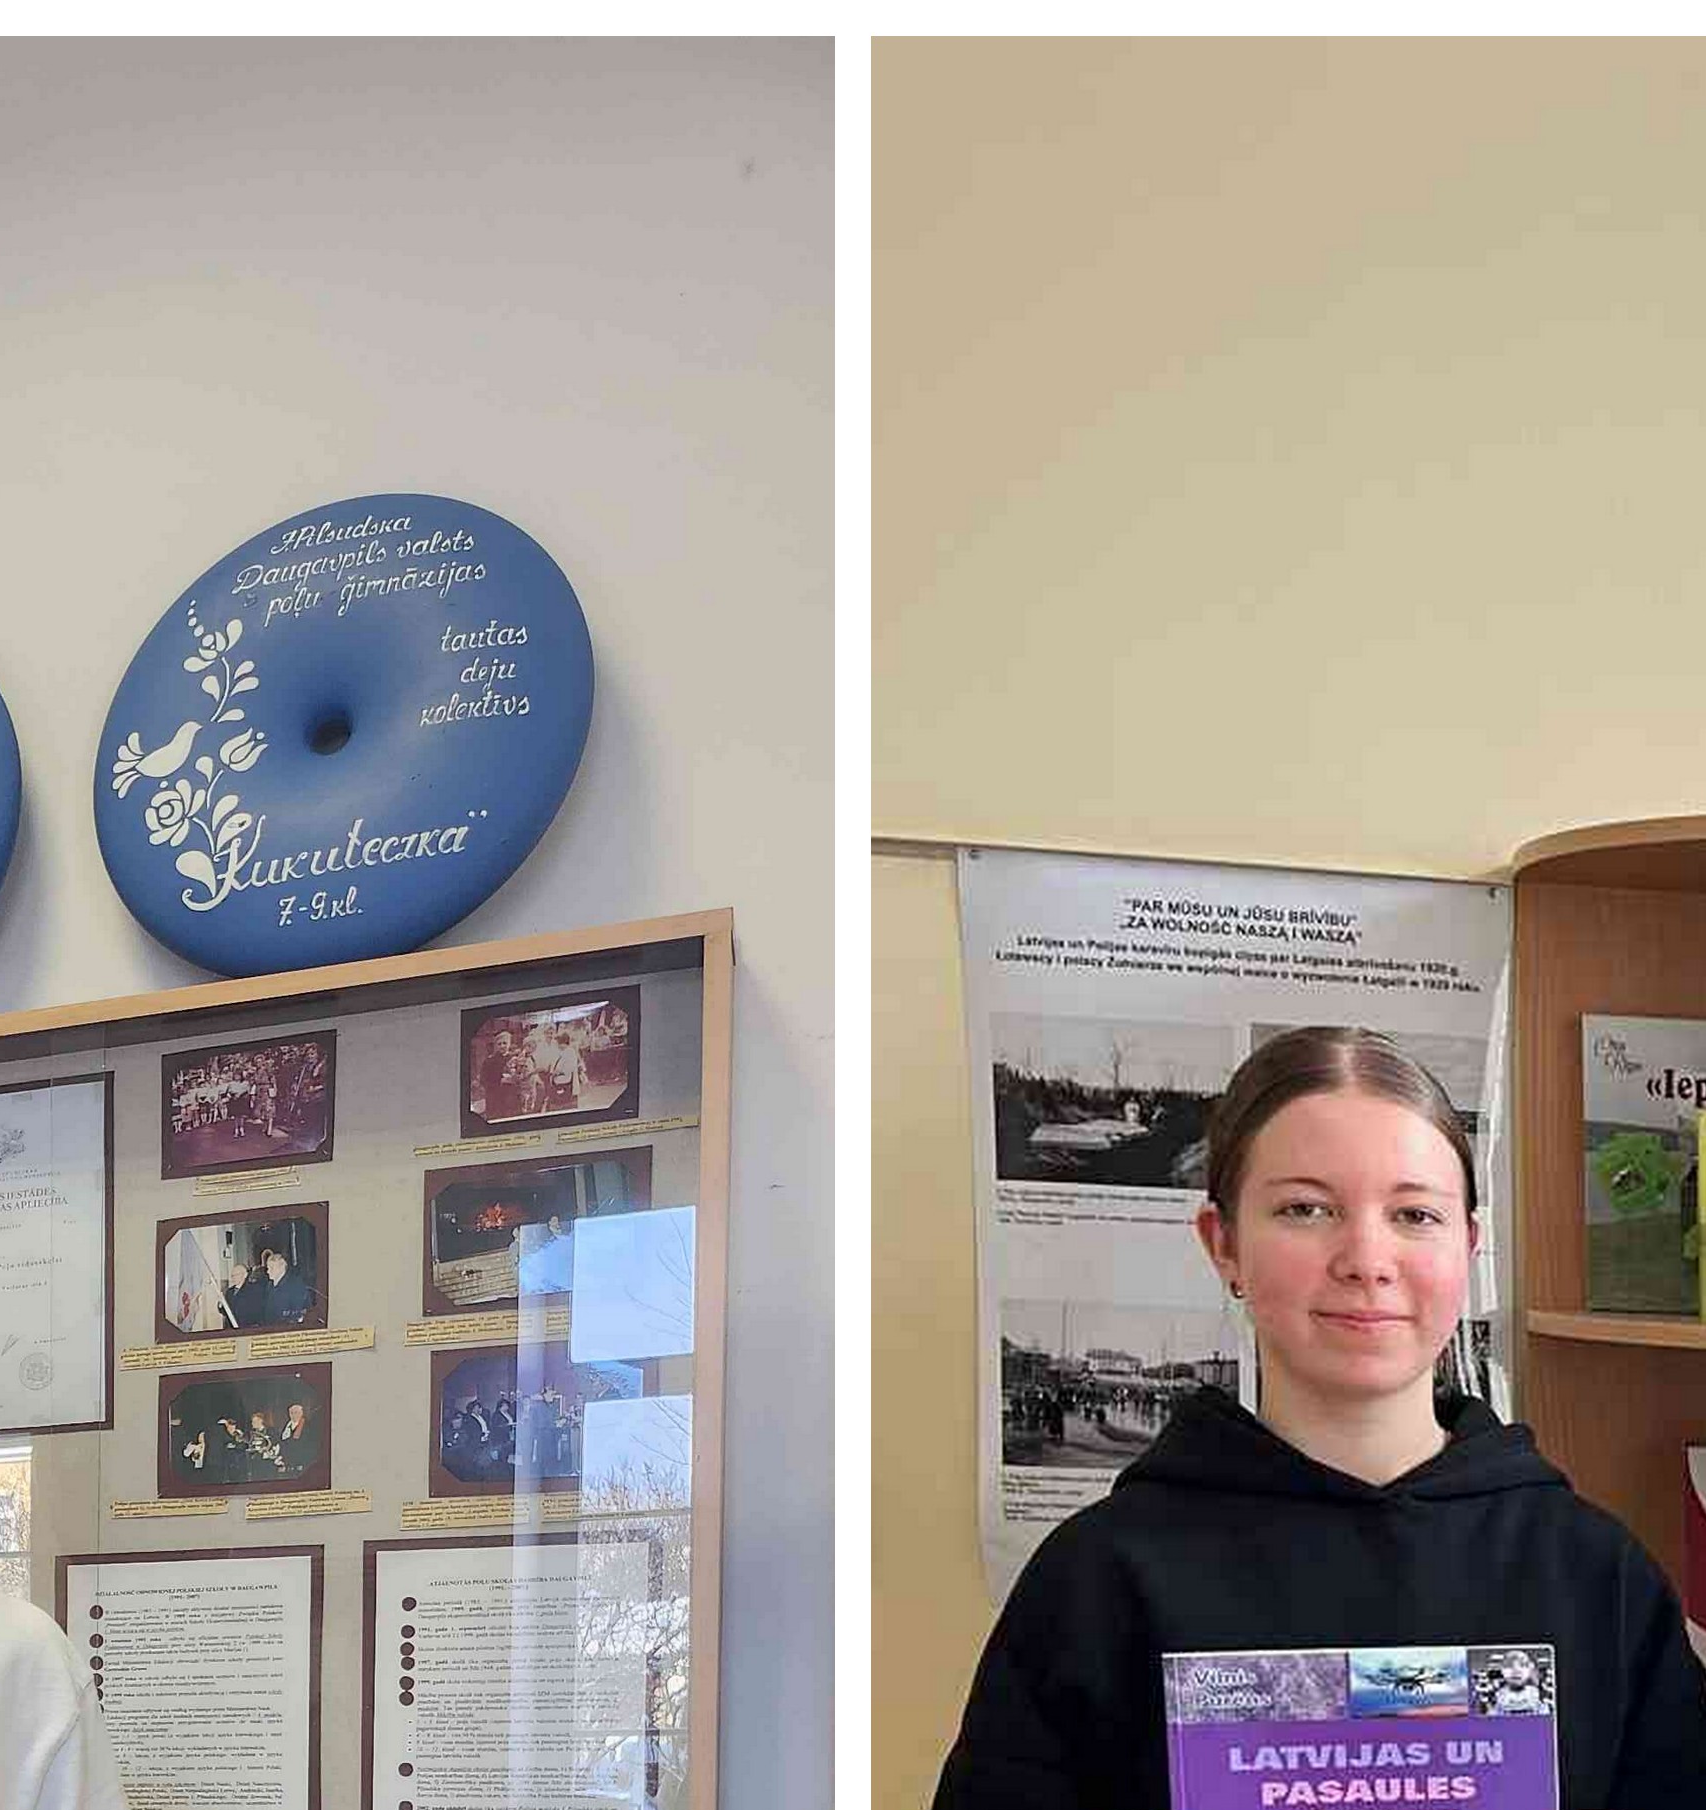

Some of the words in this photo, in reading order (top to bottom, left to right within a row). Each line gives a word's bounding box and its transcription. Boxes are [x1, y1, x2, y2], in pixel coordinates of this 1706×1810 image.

[231, 543, 387, 595] Daugavpils
[396, 529, 476, 560] valsts
[440, 619, 529, 653] tautas
[459, 656, 518, 694] deju
[419, 690, 532, 728] kolektīvs
[1217, 902, 1239, 919] UN
[1228, 1740, 1432, 1772] LATVIJAS
[1445, 1739, 1504, 1766] UN
[1260, 1774, 1477, 1807] PASAULES
